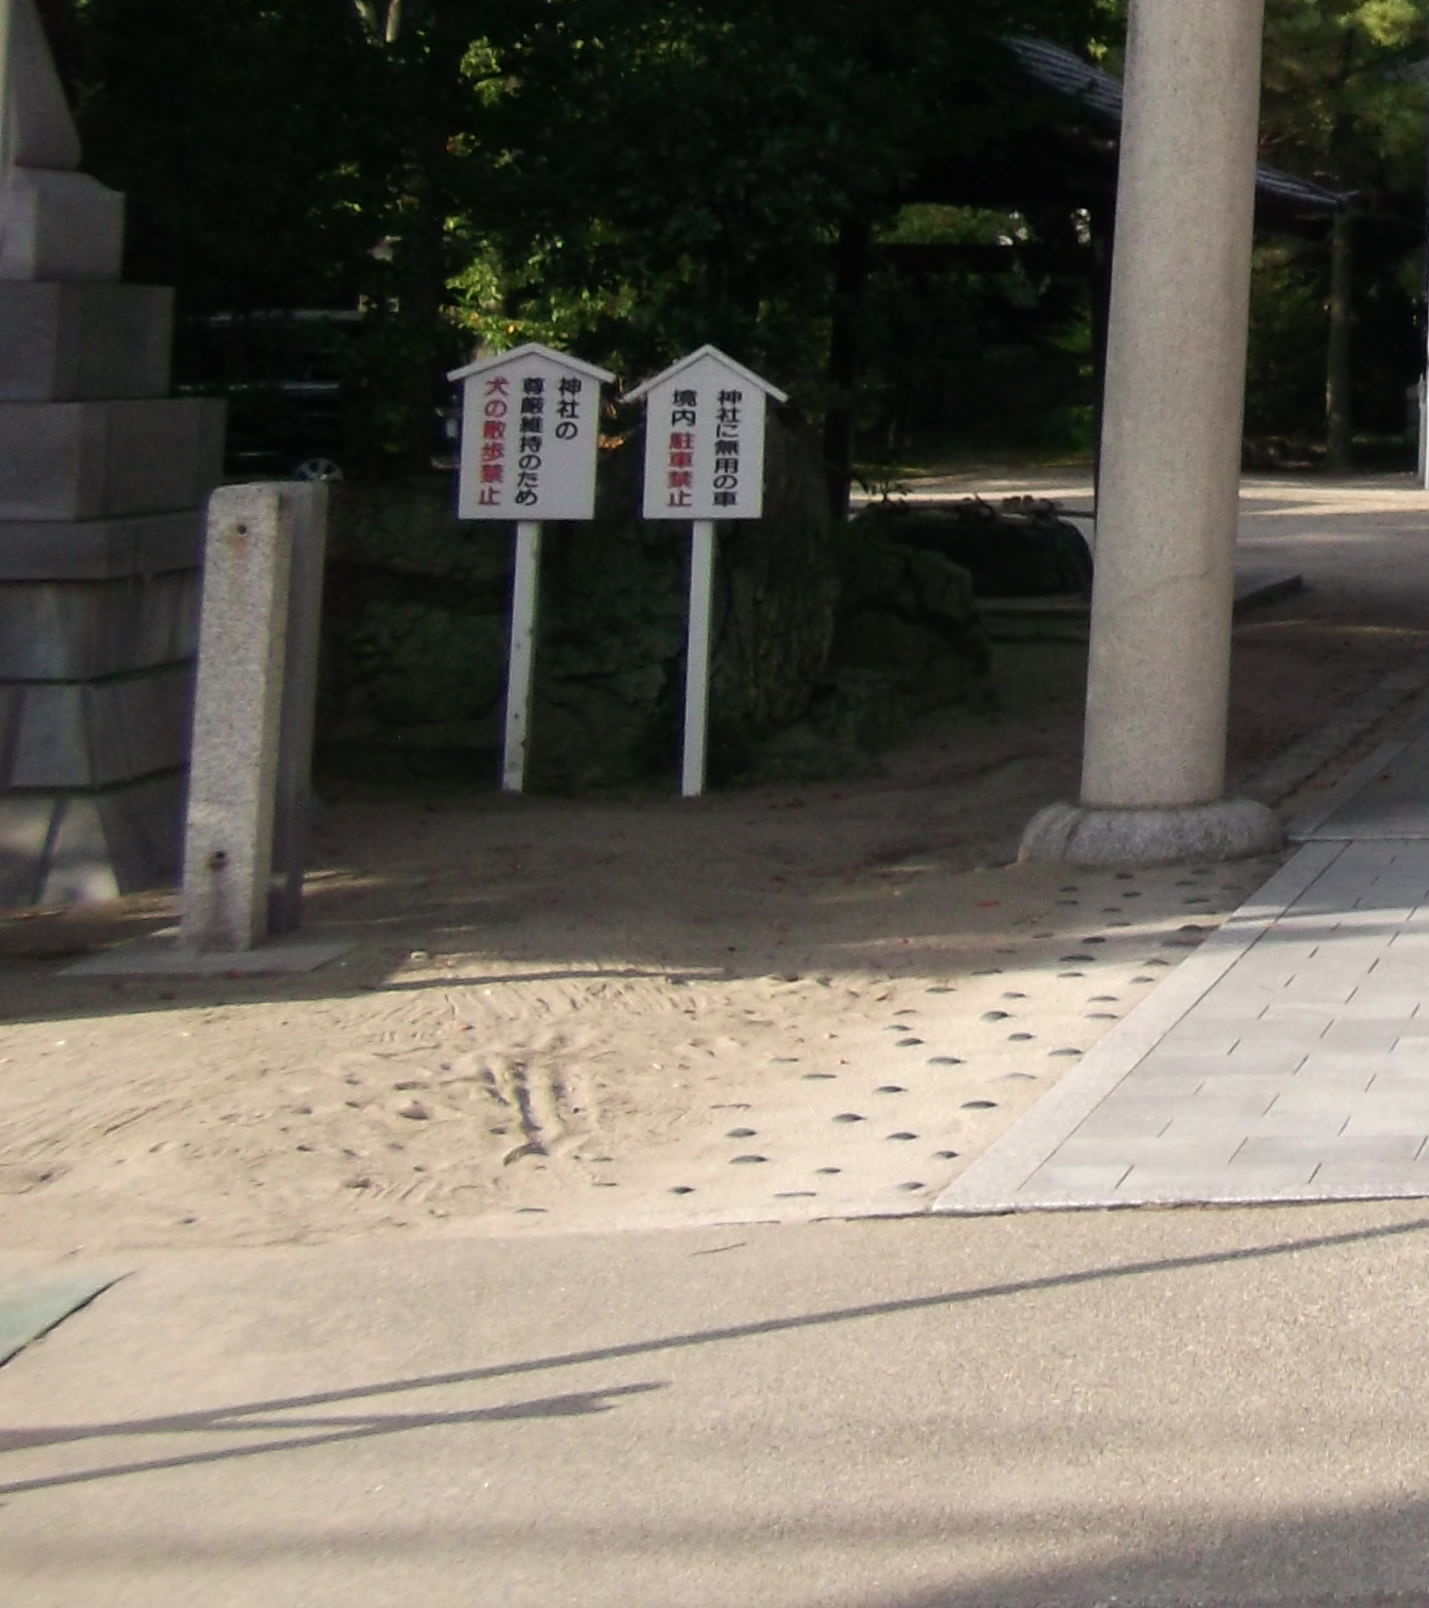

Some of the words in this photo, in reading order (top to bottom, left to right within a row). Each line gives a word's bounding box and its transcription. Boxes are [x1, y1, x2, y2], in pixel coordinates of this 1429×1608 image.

[479, 376, 511, 506] 犬の散歩禁止
[515, 376, 545, 506] 尊厳維持のため
[555, 376, 582, 440] 神社の
[712, 389, 742, 507] 神社に無用の車
